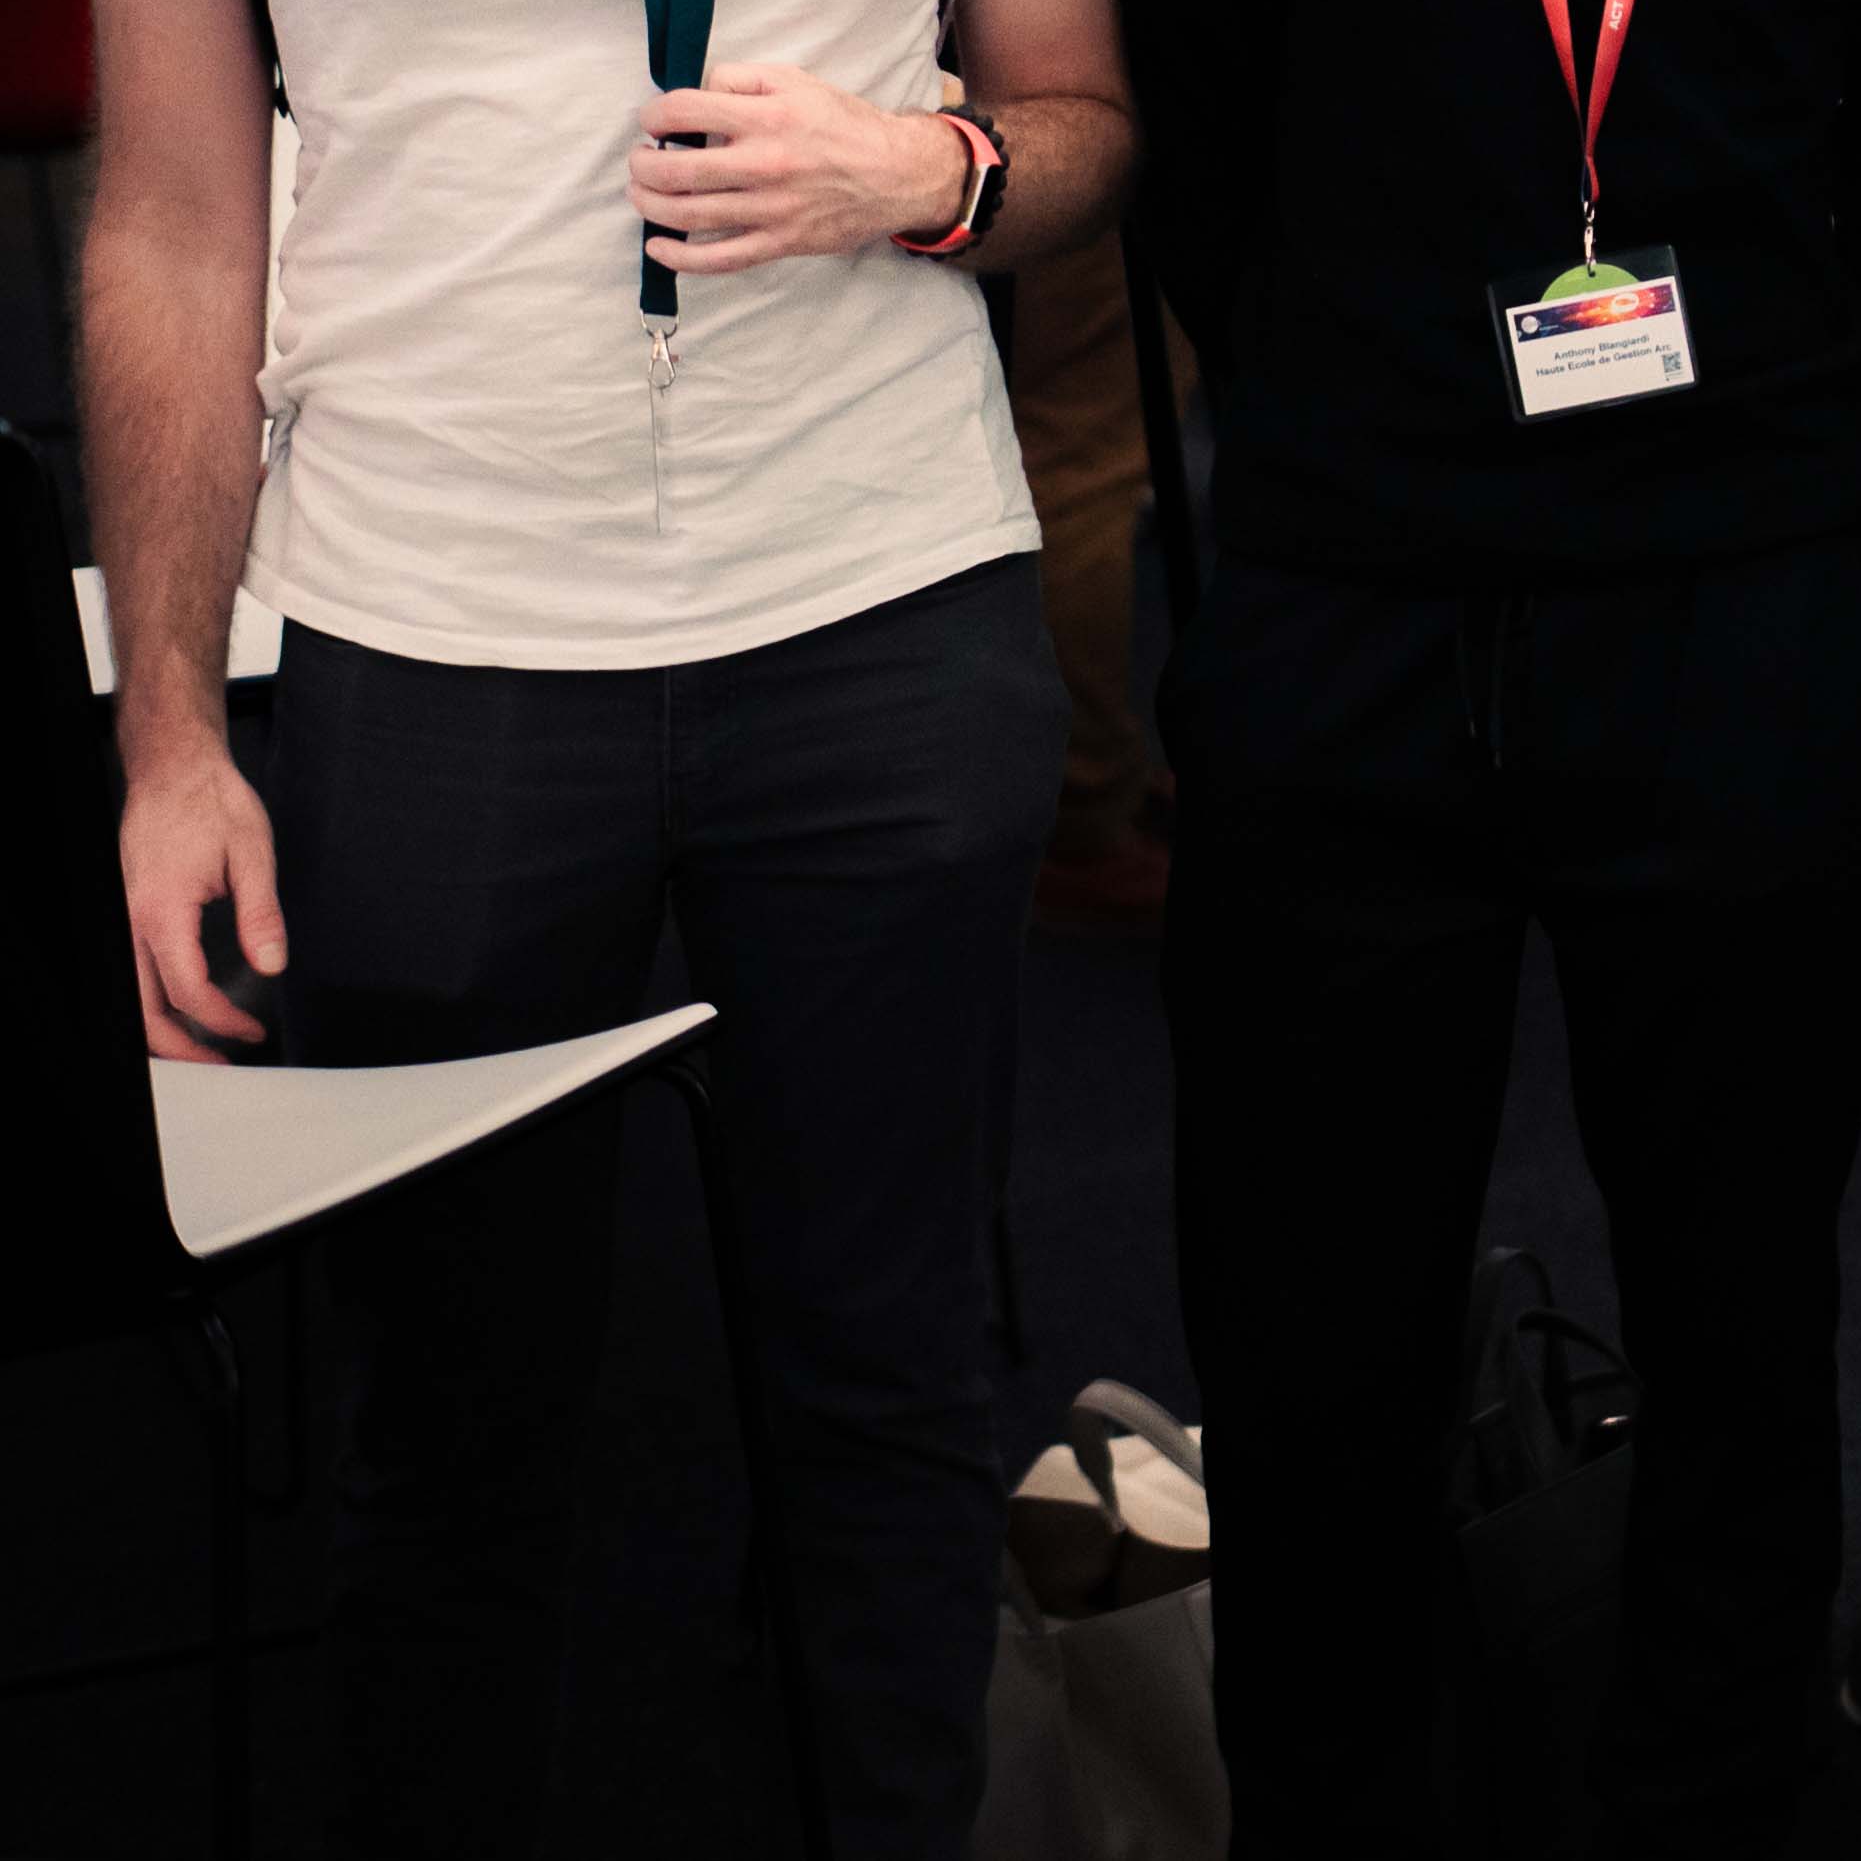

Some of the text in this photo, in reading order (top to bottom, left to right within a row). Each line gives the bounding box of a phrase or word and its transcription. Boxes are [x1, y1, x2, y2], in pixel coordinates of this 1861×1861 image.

[1609, 0, 1624, 31] ACT
[1536, 343, 1672, 377] Haute Ecole de Gestion Arc
[1554, 345, 1596, 361] Anthony
